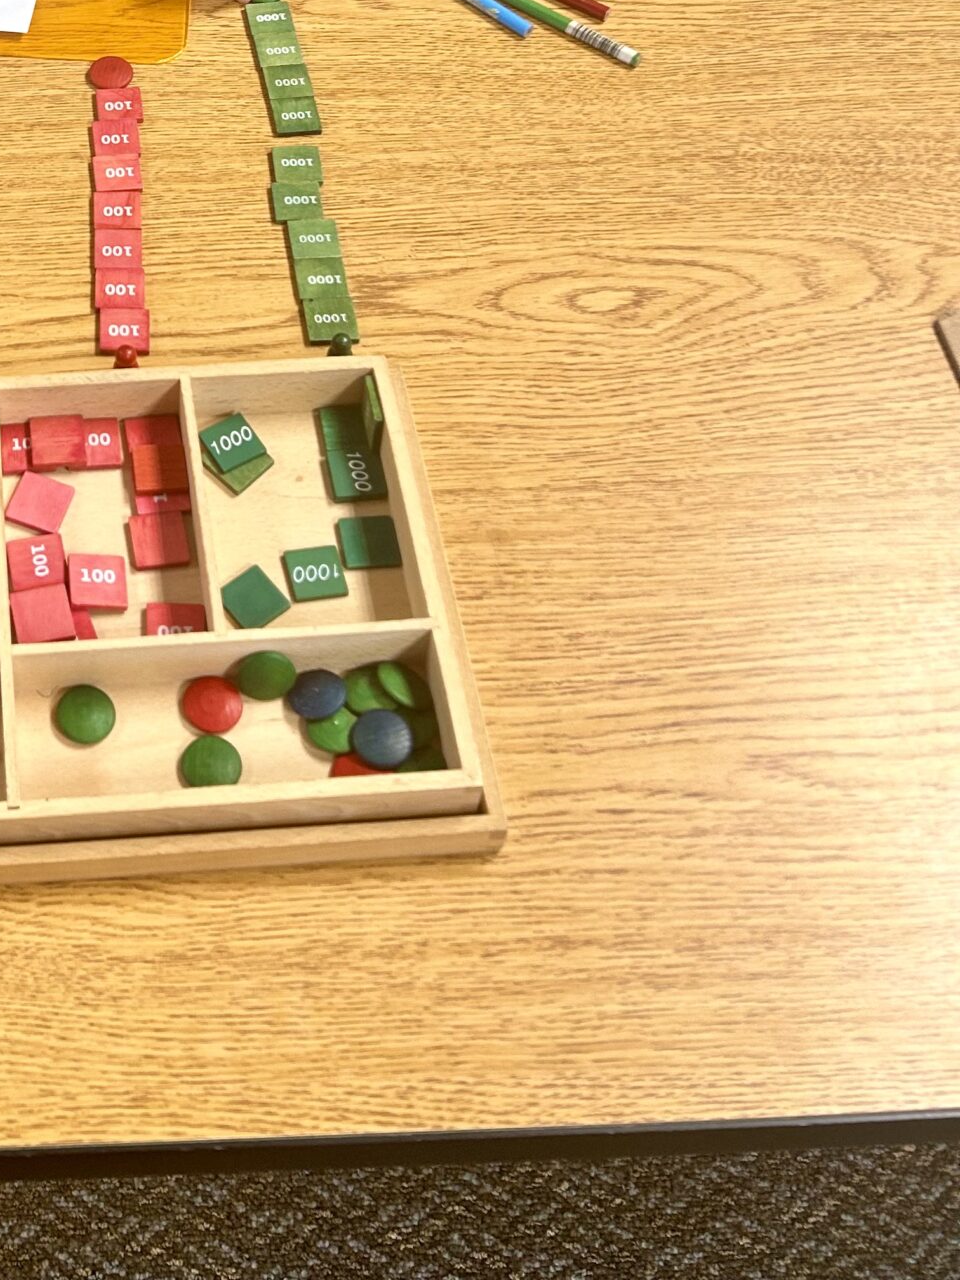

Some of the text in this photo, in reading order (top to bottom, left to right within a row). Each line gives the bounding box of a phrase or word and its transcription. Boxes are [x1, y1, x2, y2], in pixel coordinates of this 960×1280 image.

[256, 13, 287, 22] 1000
[266, 46, 296, 55] 1000
[275, 77, 306, 87] 1000
[105, 101, 132, 111] 100
[281, 111, 312, 120] 1000
[101, 134, 130, 144] 100
[281, 158, 314, 167] 1000
[105, 167, 134, 178] 100
[284, 196, 317, 205] 1000
[103, 206, 133, 217] 100
[299, 234, 332, 243] 1000
[102, 246, 132, 256] 100
[307, 275, 342, 285] 1000
[104, 284, 136, 296] 100
[314, 313, 348, 324] 1000
[108, 324, 139, 336] 100
[12, 437, 31, 450] 10
[85, 433, 111, 446] 00
[210, 426, 252, 455] 1000
[347, 451, 372, 492] 1000
[31, 544, 49, 577] 100
[80, 568, 116, 584] 100
[293, 564, 339, 583] 1000
